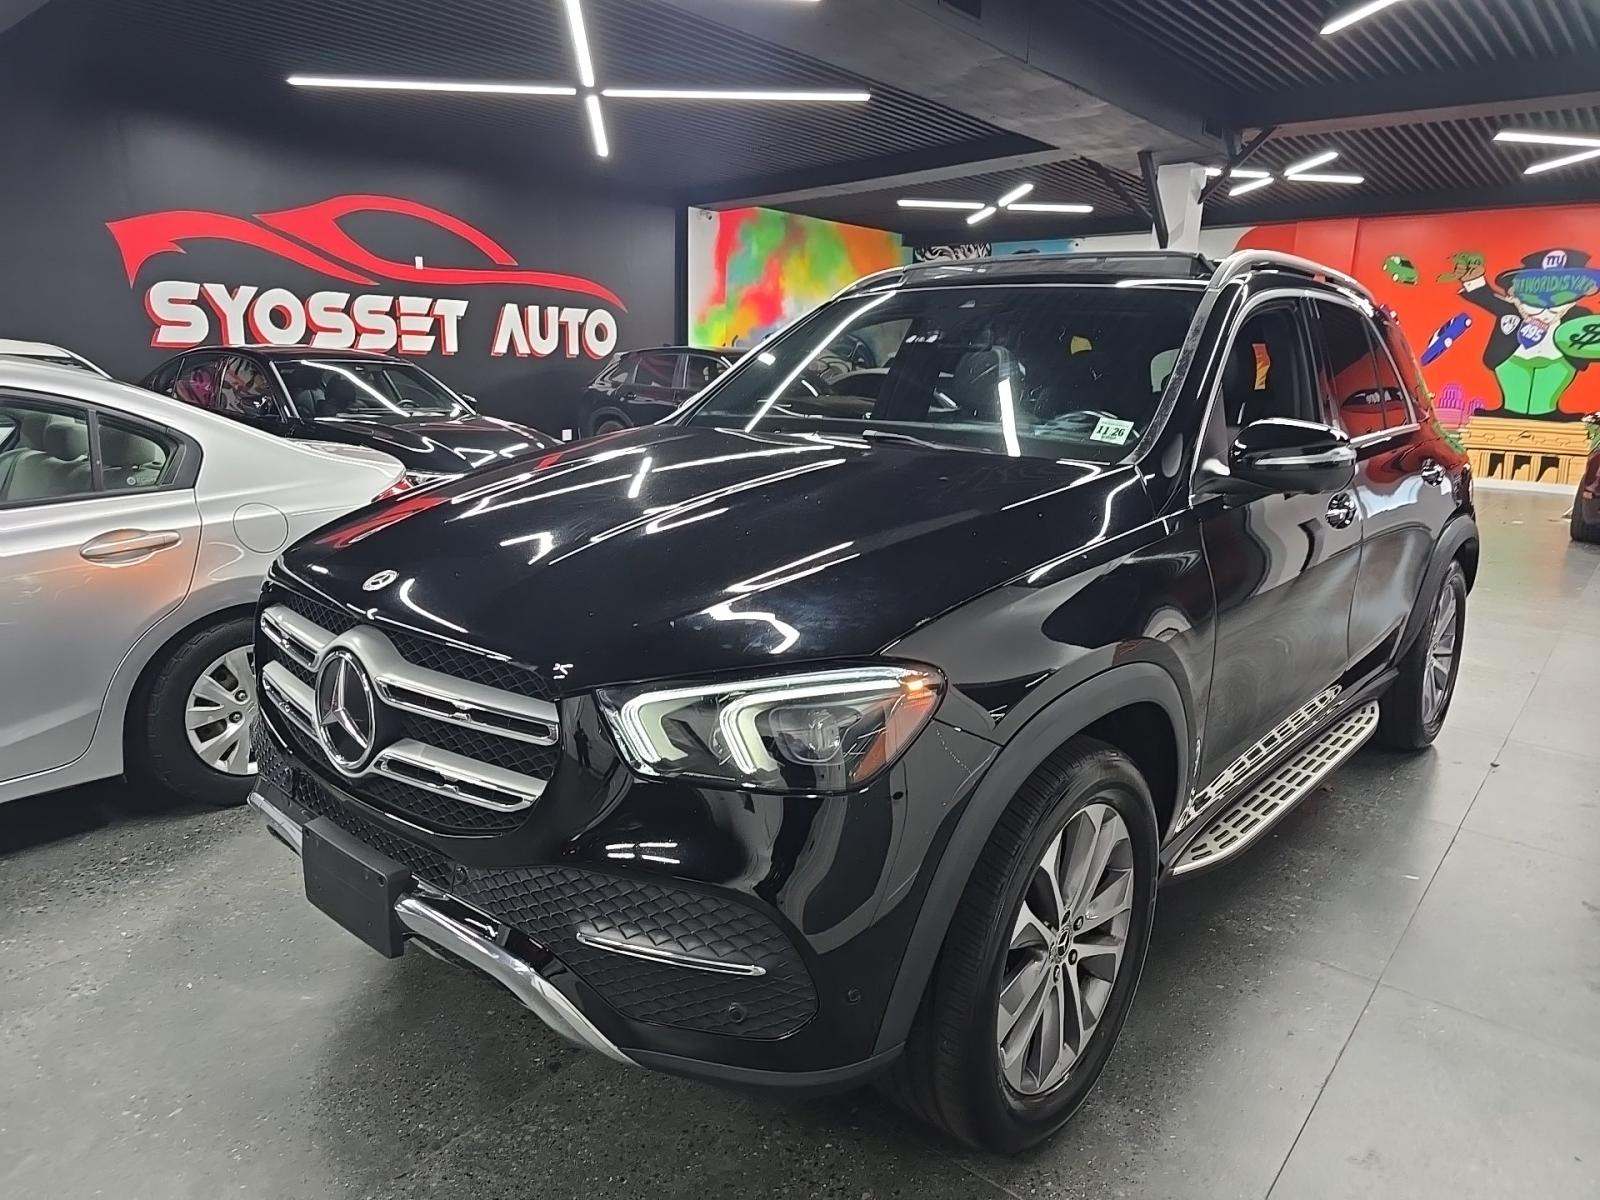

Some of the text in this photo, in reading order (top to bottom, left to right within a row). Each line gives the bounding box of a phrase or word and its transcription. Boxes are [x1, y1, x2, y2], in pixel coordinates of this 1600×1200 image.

[146, 281, 617, 359] SYOSSET AUTO
[1520, 323, 1544, 342] 495
